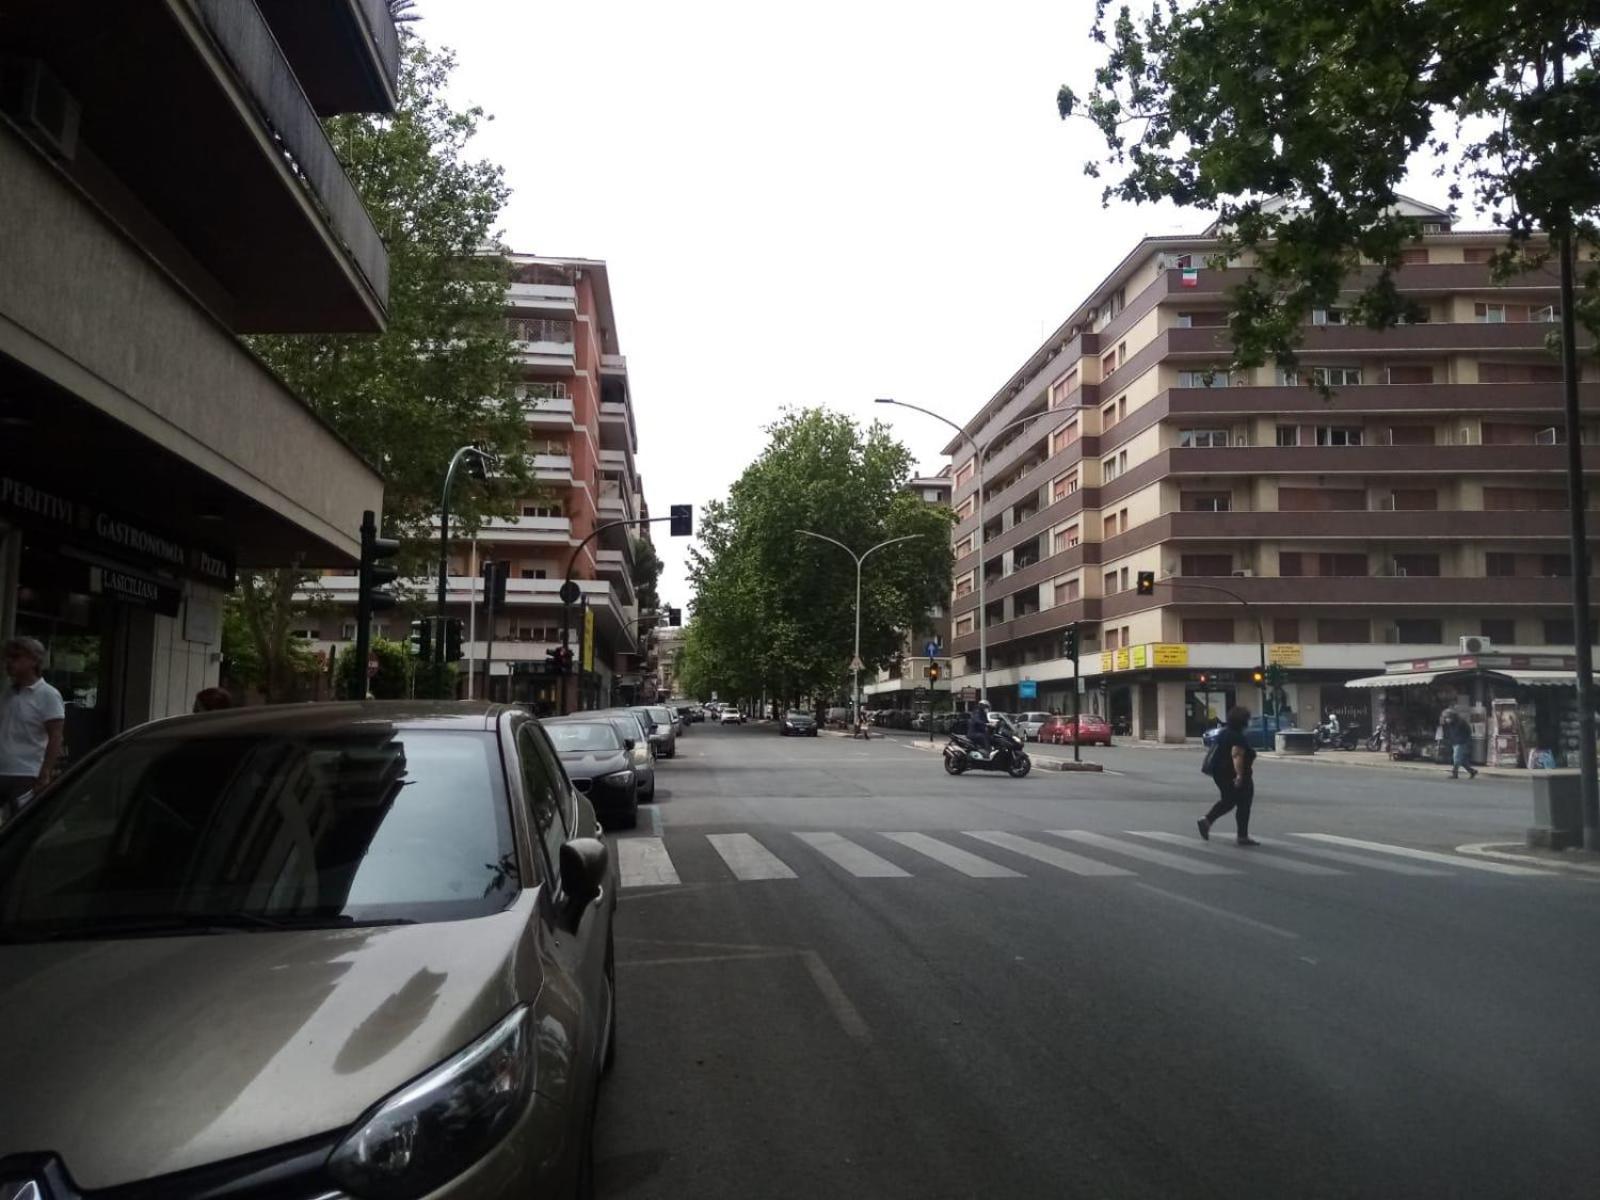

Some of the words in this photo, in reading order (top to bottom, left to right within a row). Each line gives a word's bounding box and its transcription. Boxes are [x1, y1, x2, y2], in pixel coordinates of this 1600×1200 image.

[0, 477, 73, 524] PERITIVI
[96, 512, 185, 564] GASTRONOMIA
[200, 552, 228, 579] PIZZA
